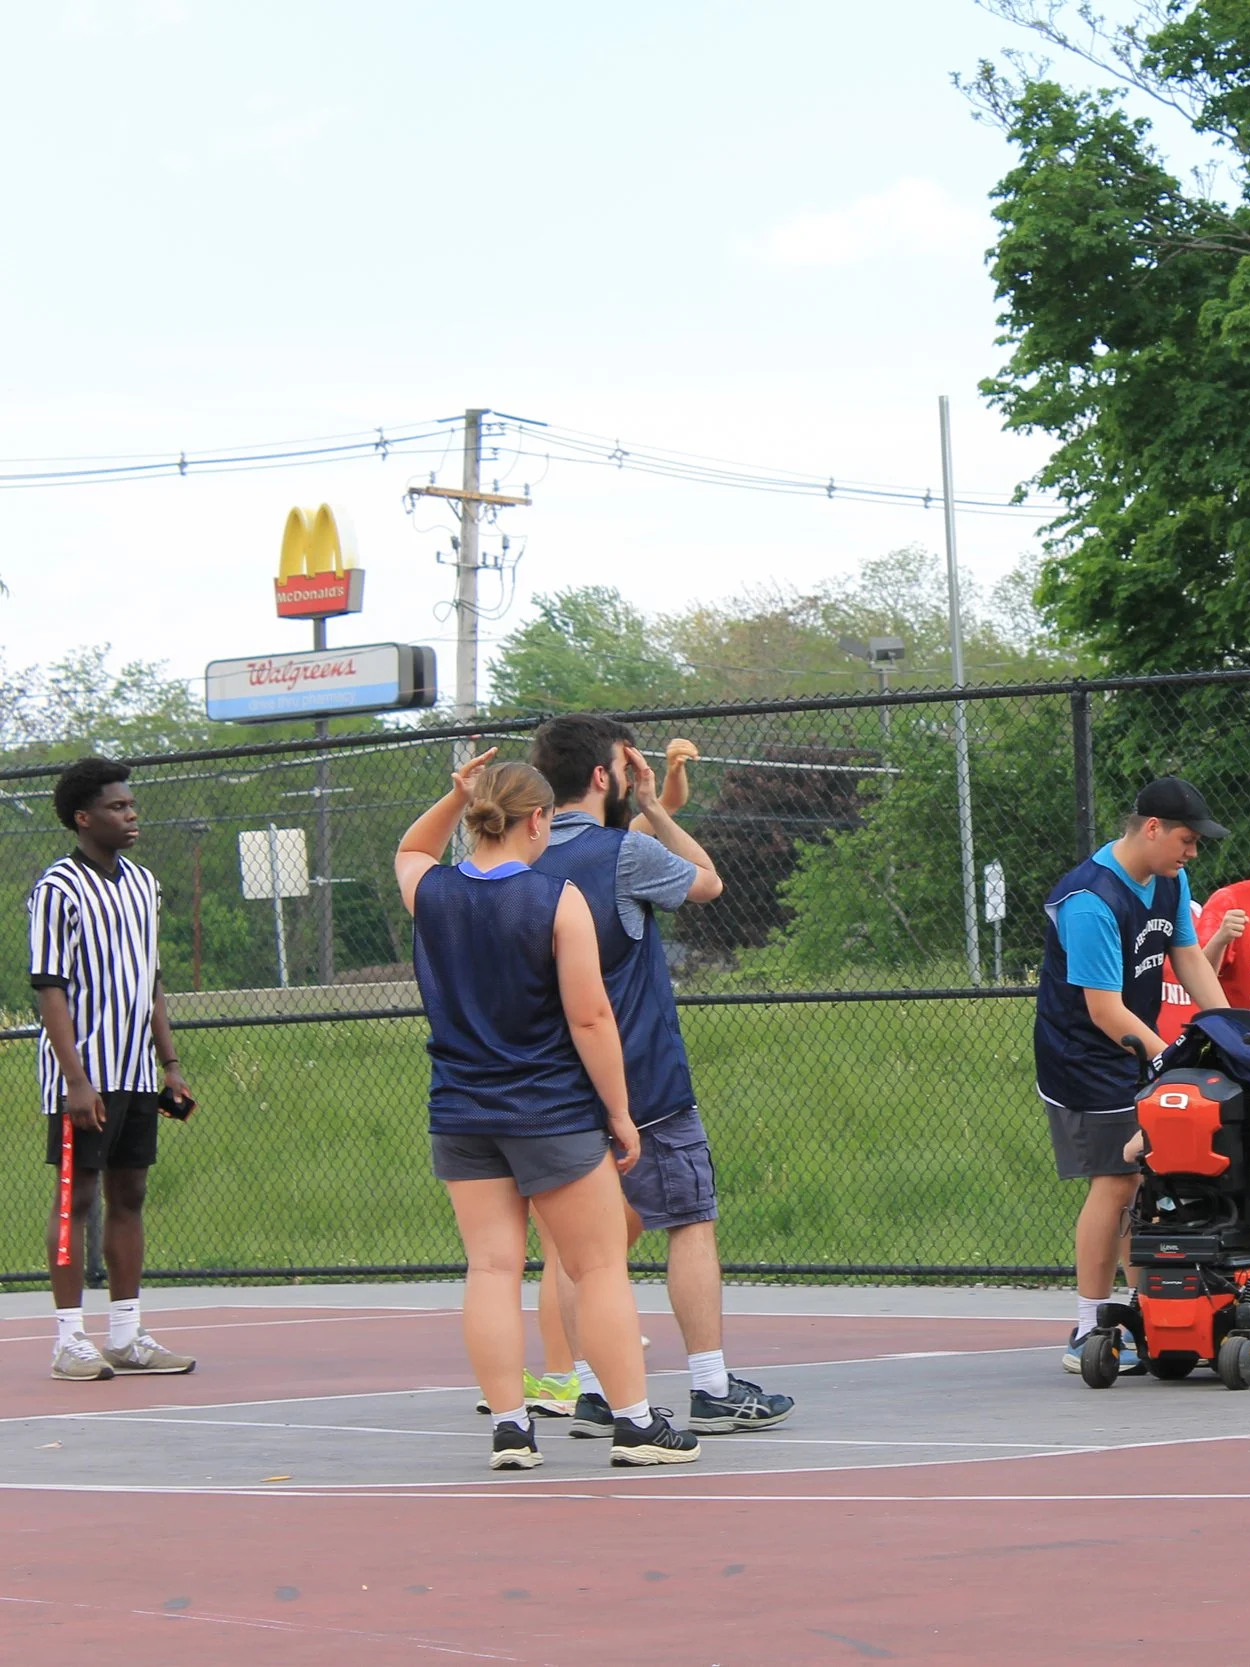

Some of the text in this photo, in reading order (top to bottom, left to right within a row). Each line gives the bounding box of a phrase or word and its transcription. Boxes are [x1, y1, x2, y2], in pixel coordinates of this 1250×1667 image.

[277, 586, 345, 603] McDonald's
[247, 658, 357, 691] Walgreens
[1160, 1092, 1189, 1110] Q
